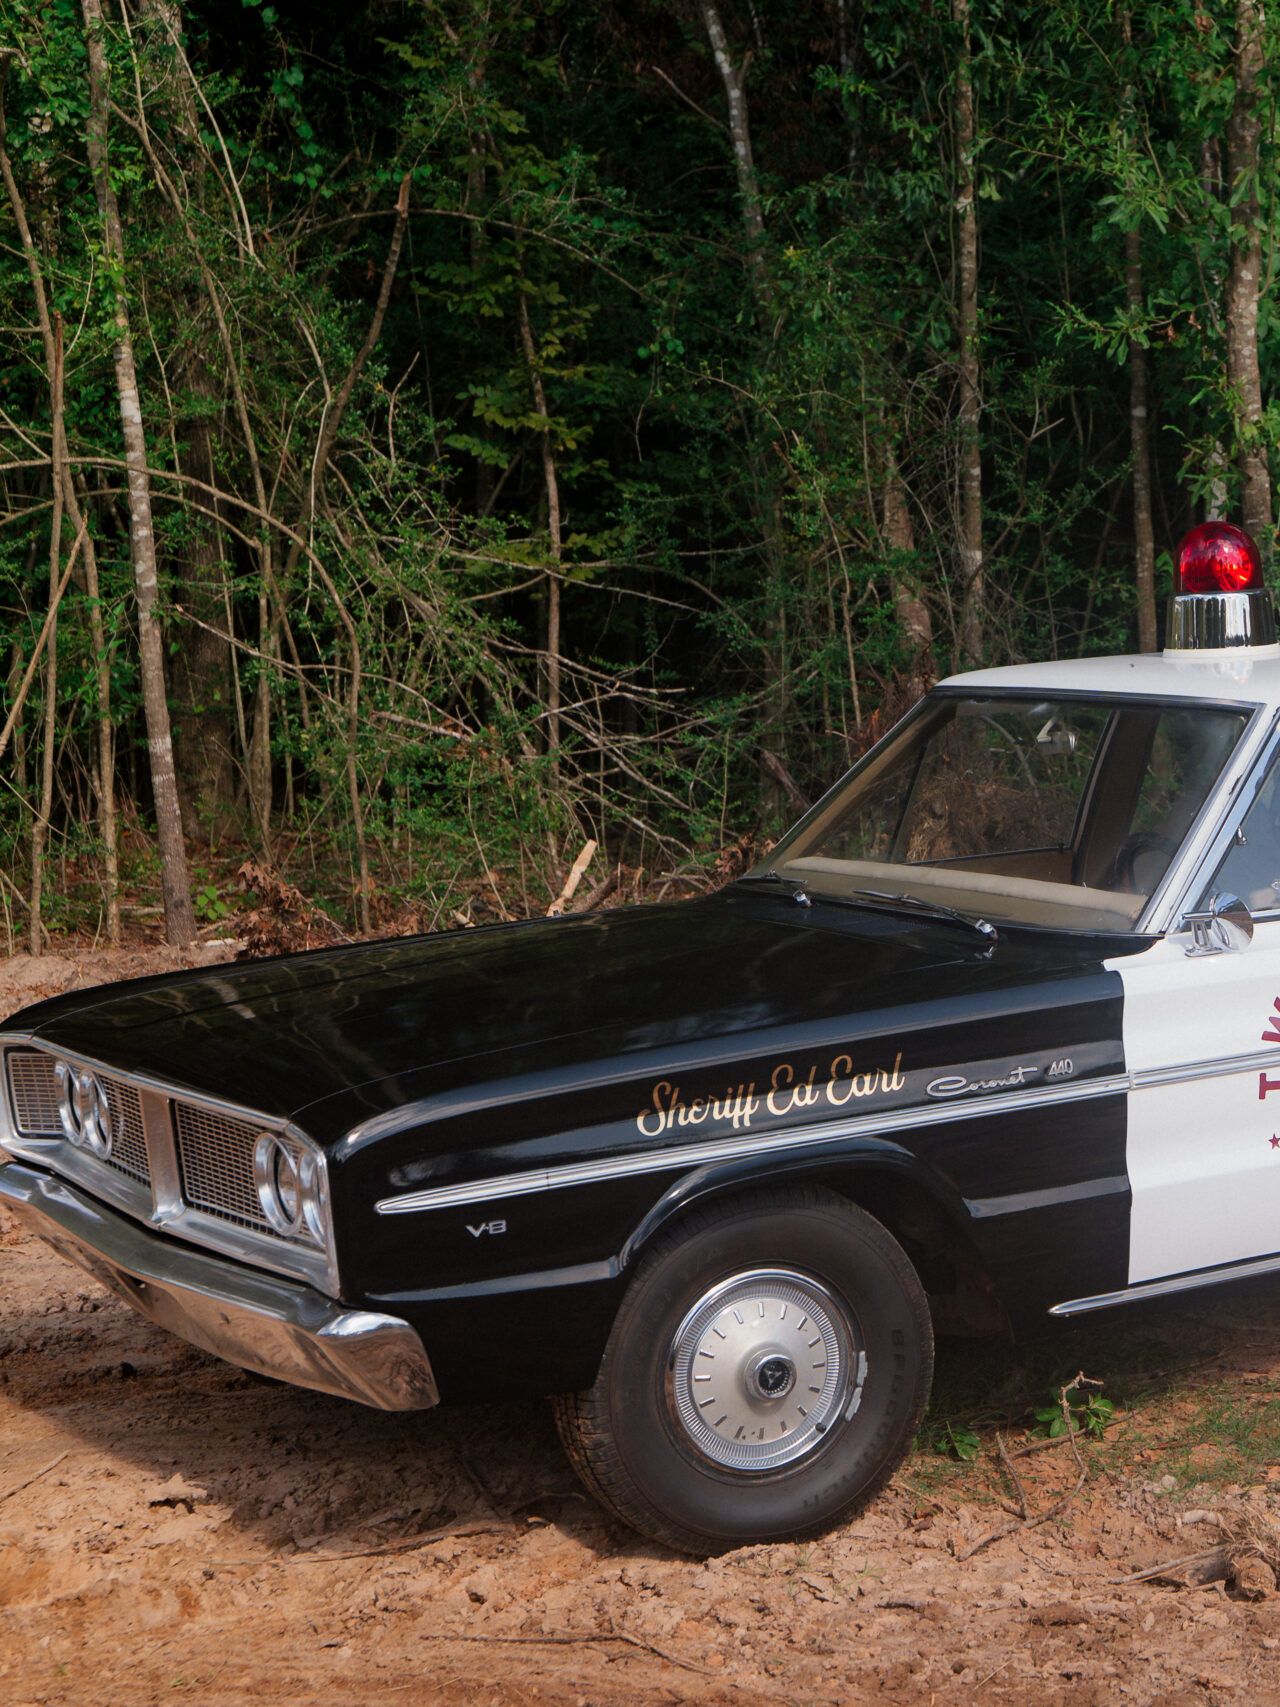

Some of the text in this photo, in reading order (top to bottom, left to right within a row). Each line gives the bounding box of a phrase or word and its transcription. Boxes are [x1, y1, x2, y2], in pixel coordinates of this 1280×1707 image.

[637, 1052, 905, 1136] Sheriff Ed Earl
[926, 1058, 1073, 1097] Coronet 440
